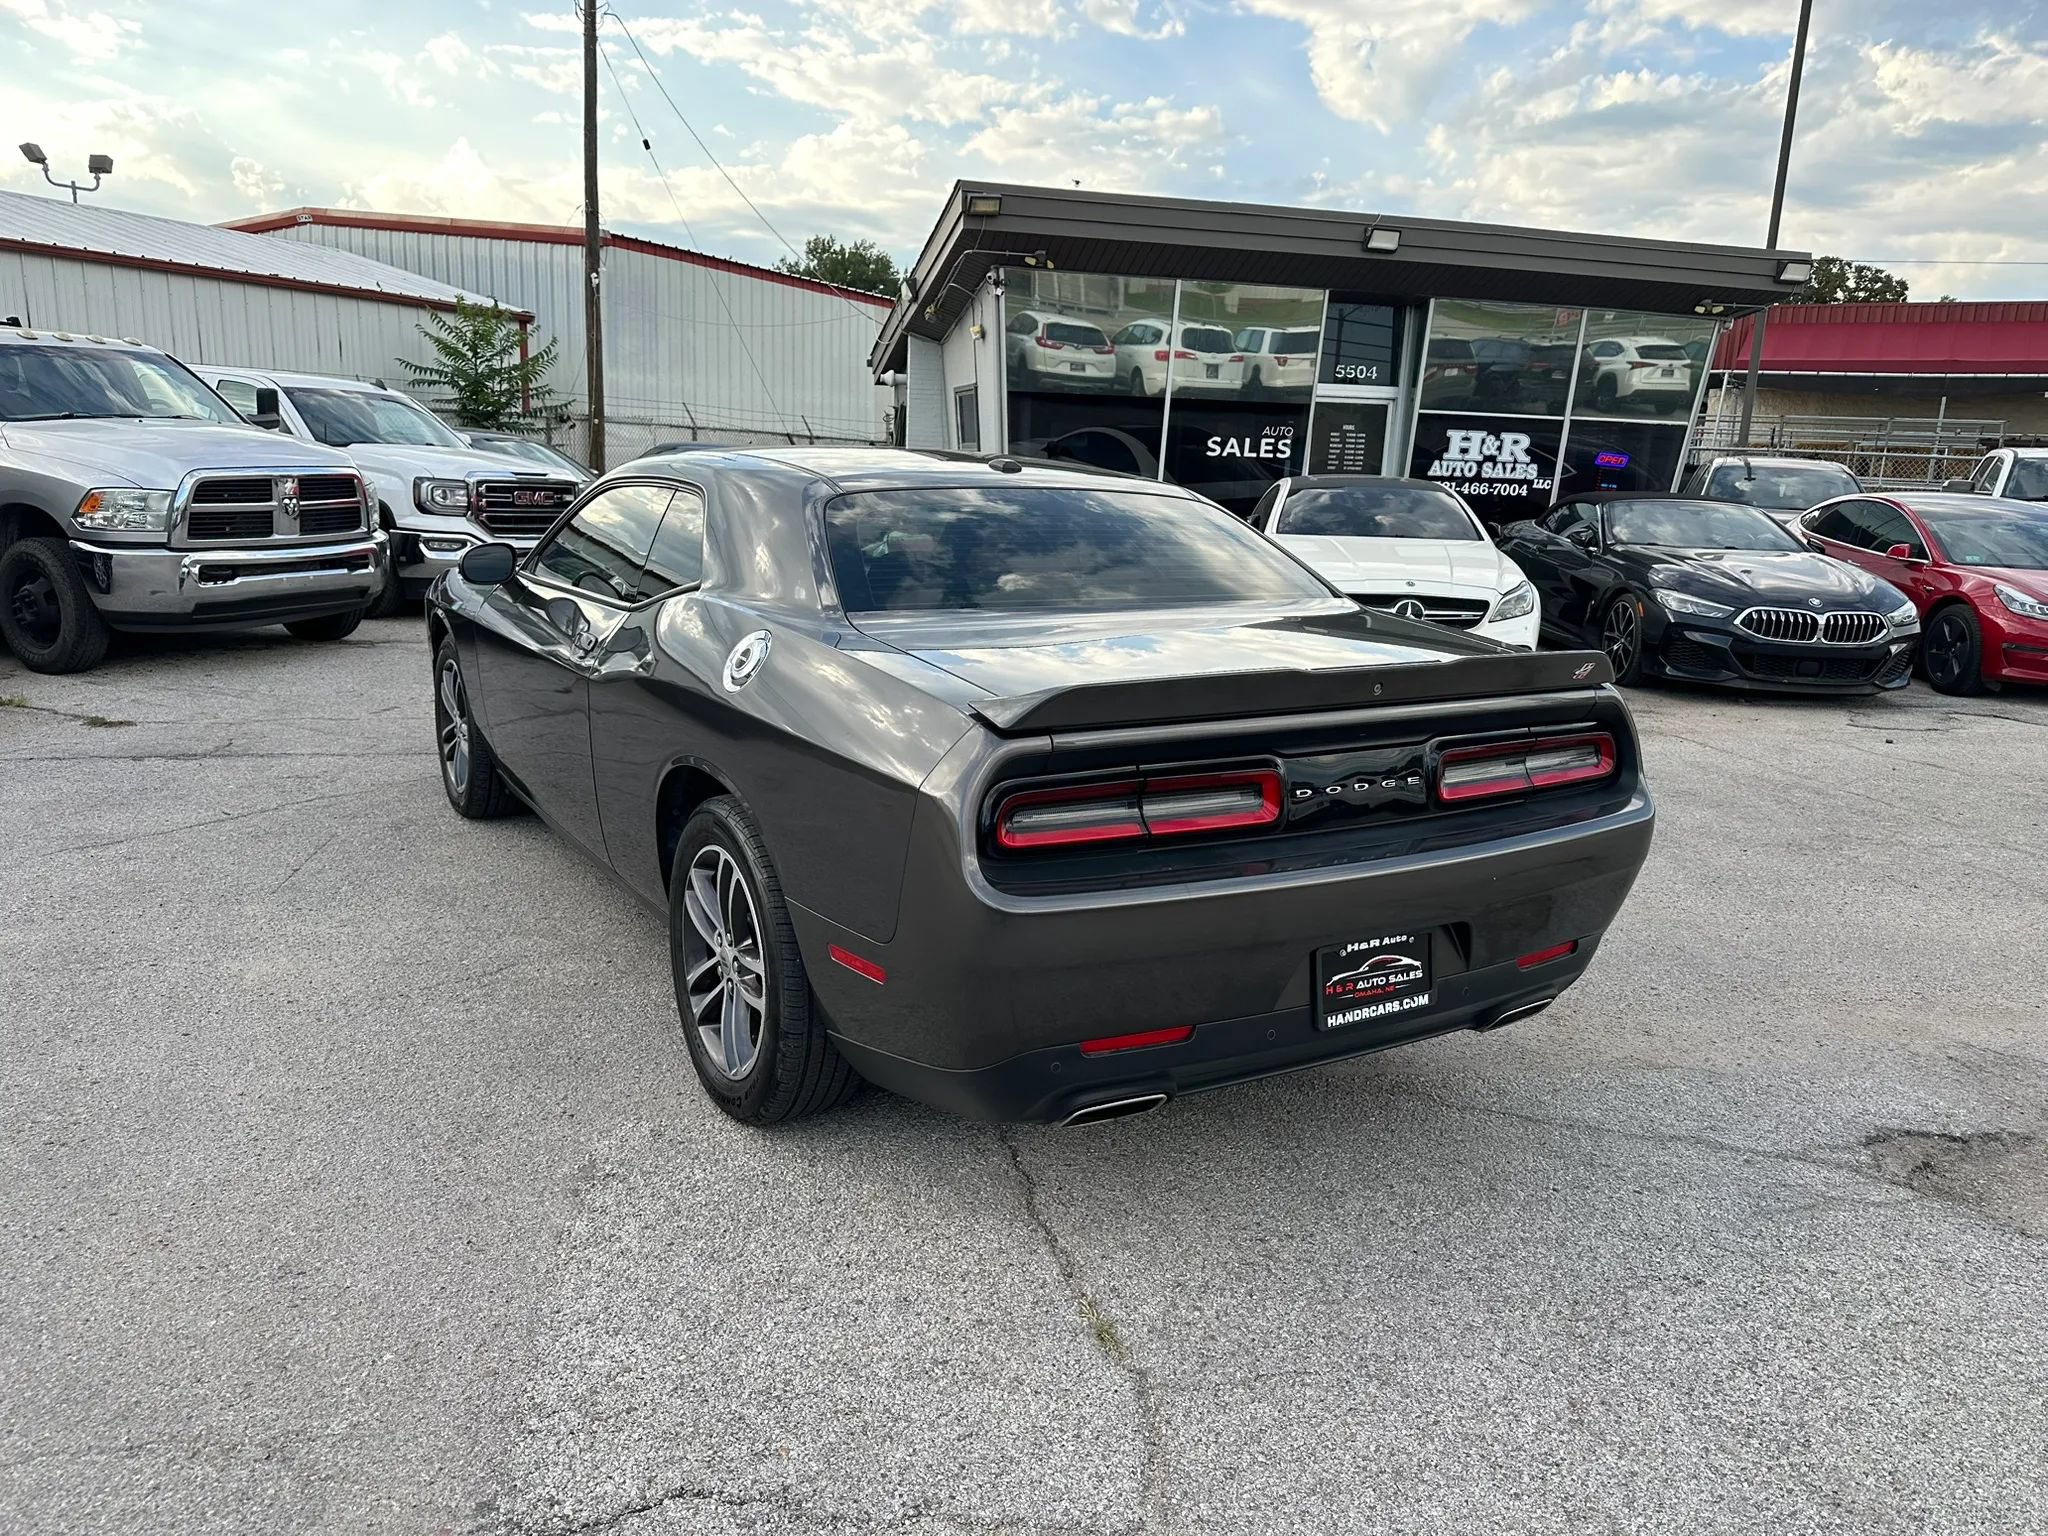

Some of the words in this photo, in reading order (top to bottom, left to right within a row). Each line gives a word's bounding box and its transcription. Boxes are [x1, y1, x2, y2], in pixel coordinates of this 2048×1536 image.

[1334, 364, 1378, 380] 5504
[1261, 425, 1294, 437] AUTO
[1205, 436, 1292, 459] SALES
[1443, 429, 1531, 463] H&R
[1427, 459, 1478, 478] AUTO
[1481, 461, 1538, 480] SALES
[1599, 454, 1626, 465] OPEN
[1532, 479, 1552, 489] LLC
[513, 491, 554, 506] GMC
[1296, 776, 1420, 798] DODGE
[1346, 938, 1381, 953] H&R
[1382, 934, 1407, 946] Auto
[1325, 986, 1334, 996] H
[1345, 982, 1354, 991] R
[1356, 977, 1387, 990] AUTO
[1388, 969, 1423, 984] SALES
[1327, 993, 1429, 1028] HANDRCARS.COM
